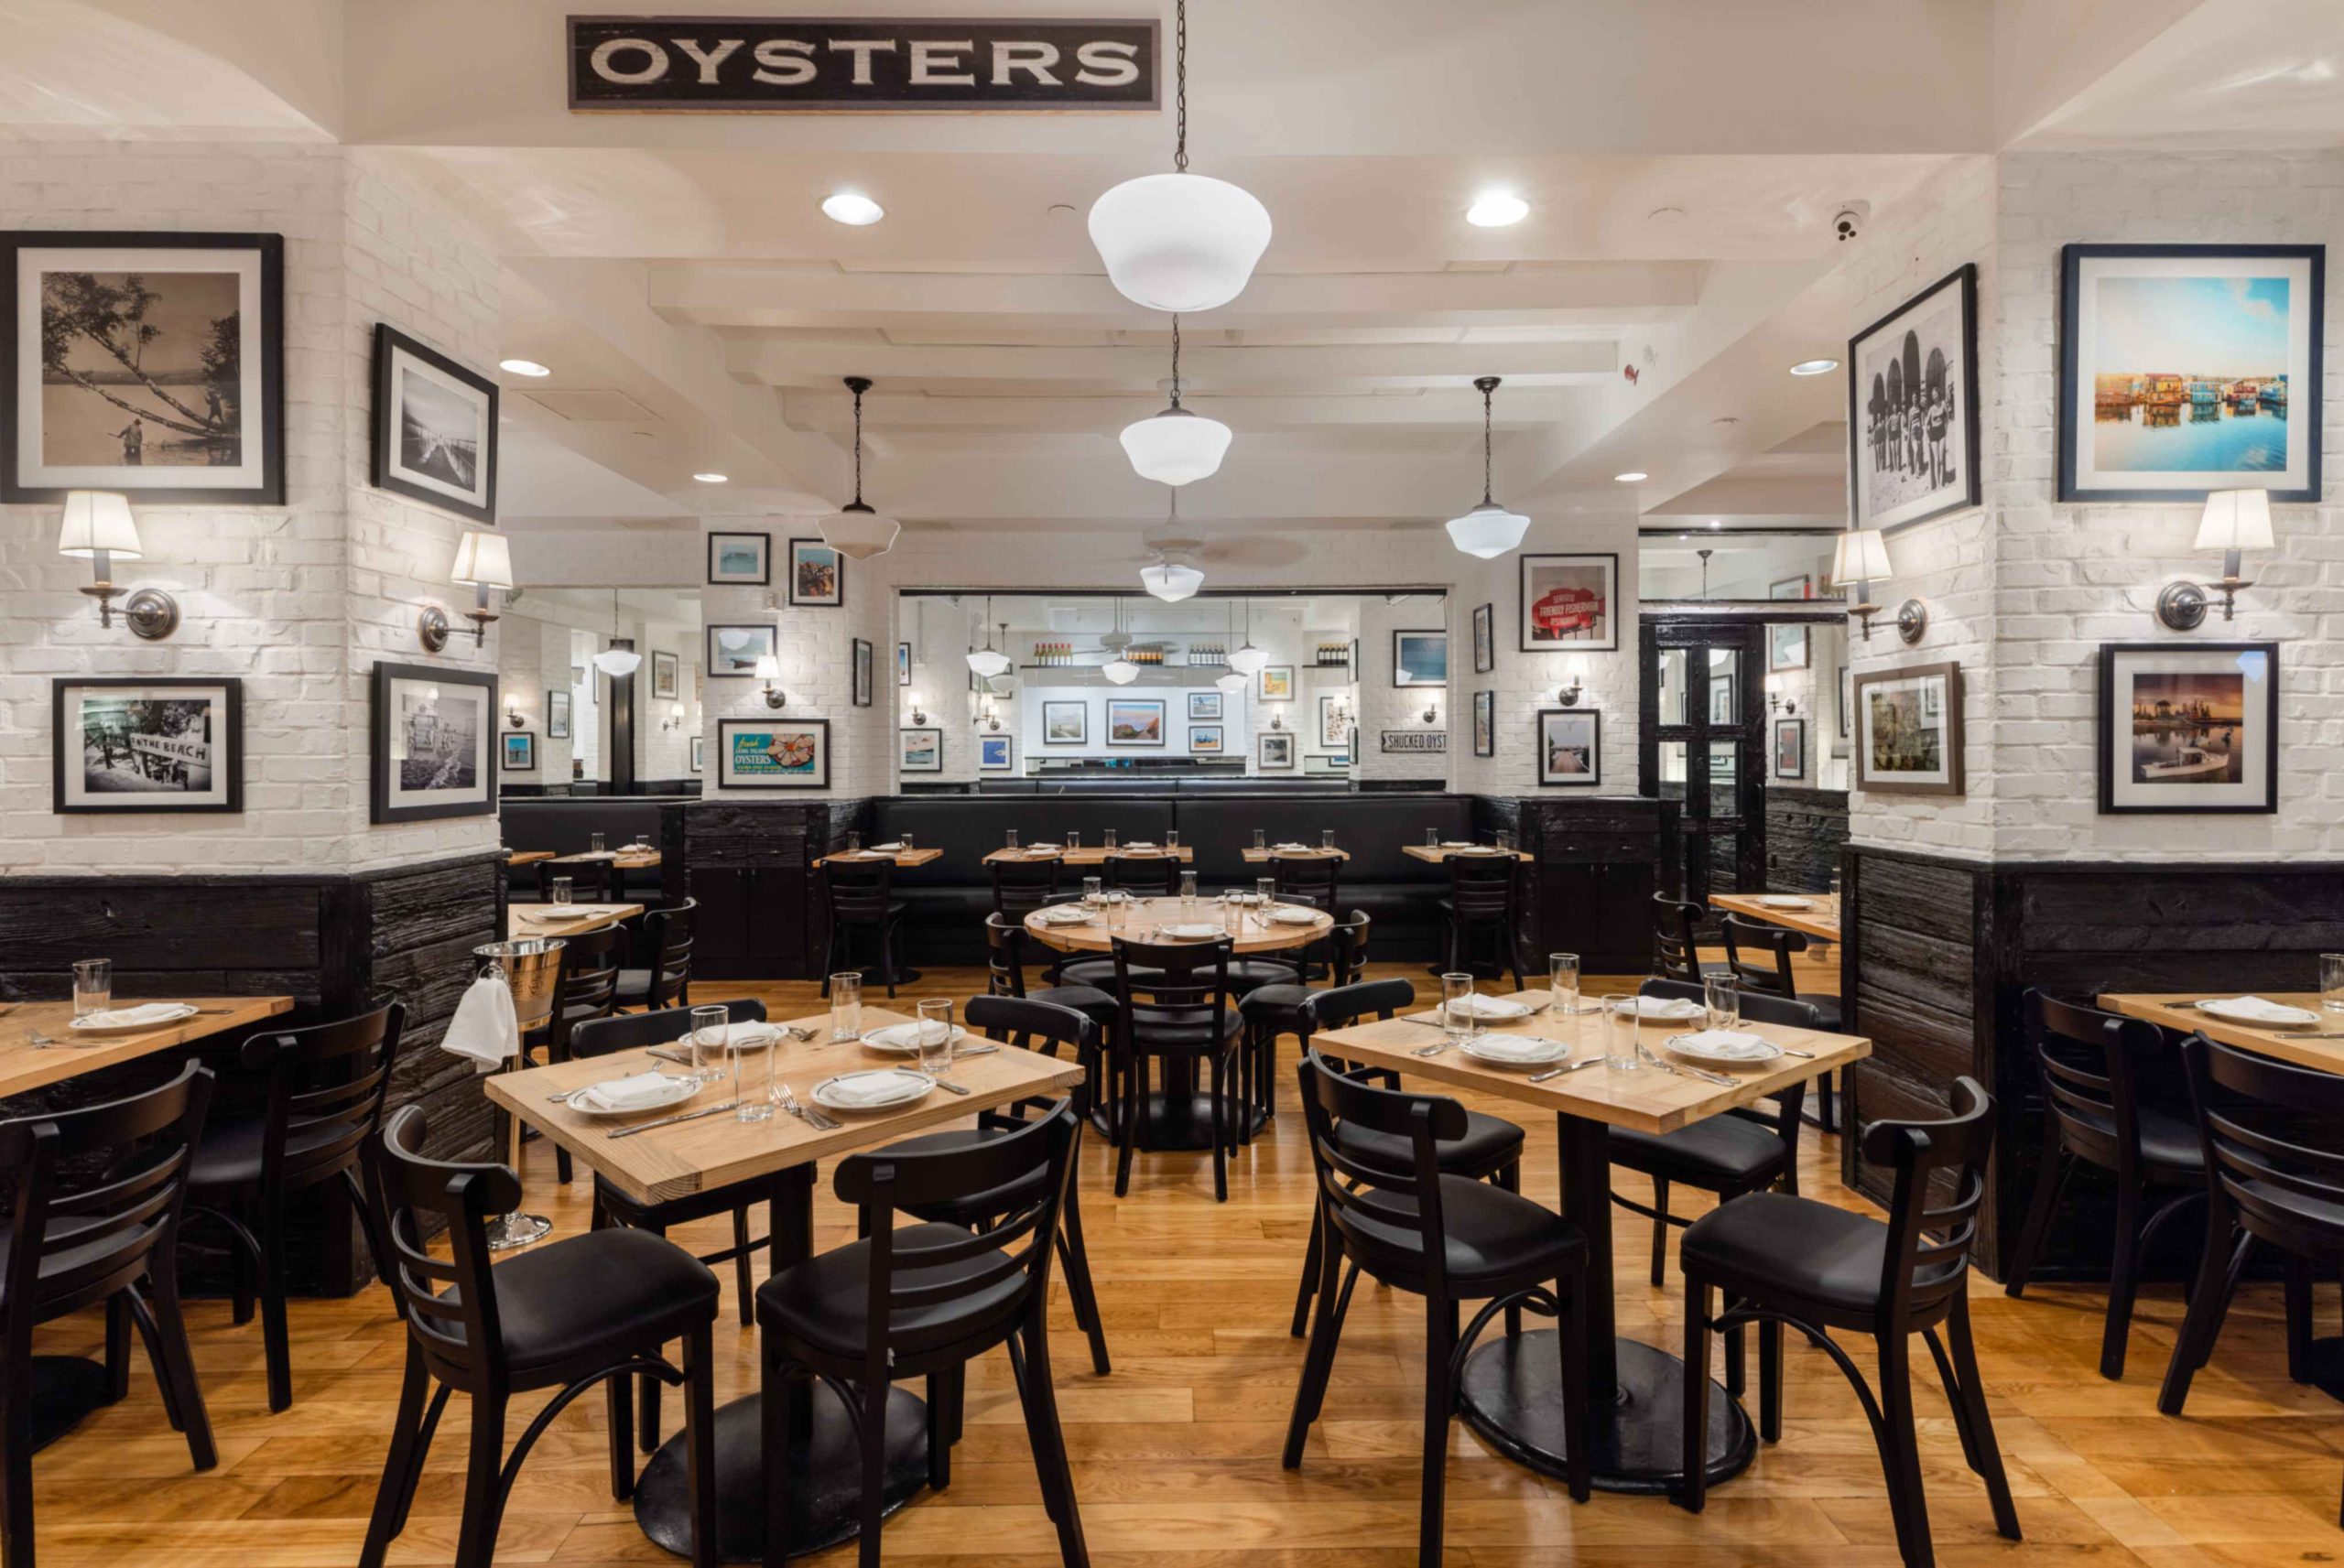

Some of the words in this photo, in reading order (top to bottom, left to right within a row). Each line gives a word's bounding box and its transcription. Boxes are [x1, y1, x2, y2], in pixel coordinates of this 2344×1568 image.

[589, 38, 1141, 86] OYSTERS
[1539, 605, 1565, 617] FRIENDLY
[1388, 734, 1425, 748] SHUCKED
[143, 739, 160, 749] THE
[164, 741, 206, 760] BEACH
[735, 754, 771, 765] OYSTERS
